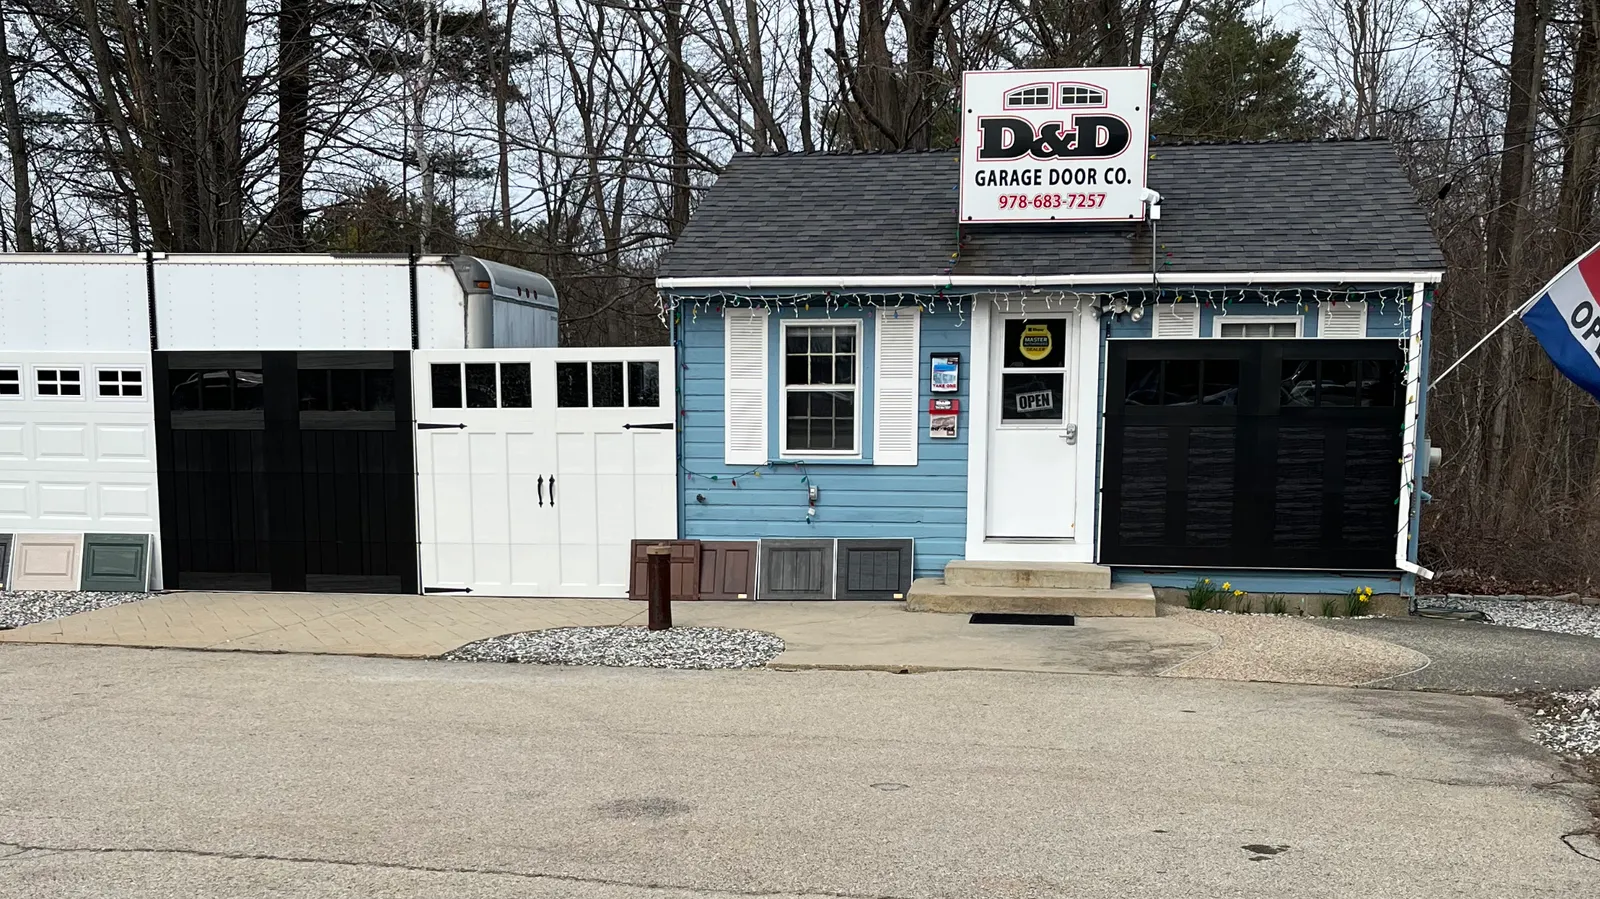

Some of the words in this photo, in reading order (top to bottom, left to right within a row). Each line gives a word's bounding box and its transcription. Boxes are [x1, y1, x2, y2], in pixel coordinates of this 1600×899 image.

[977, 113, 1132, 162] D&D
[975, 169, 1042, 186] GARAGE
[1049, 168, 1097, 185] DOOR
[1104, 167, 1132, 184] CO.
[999, 193, 1106, 209] 978-683-7257
[1571, 301, 1600, 360] OP
[1019, 393, 1050, 410] OPEN
